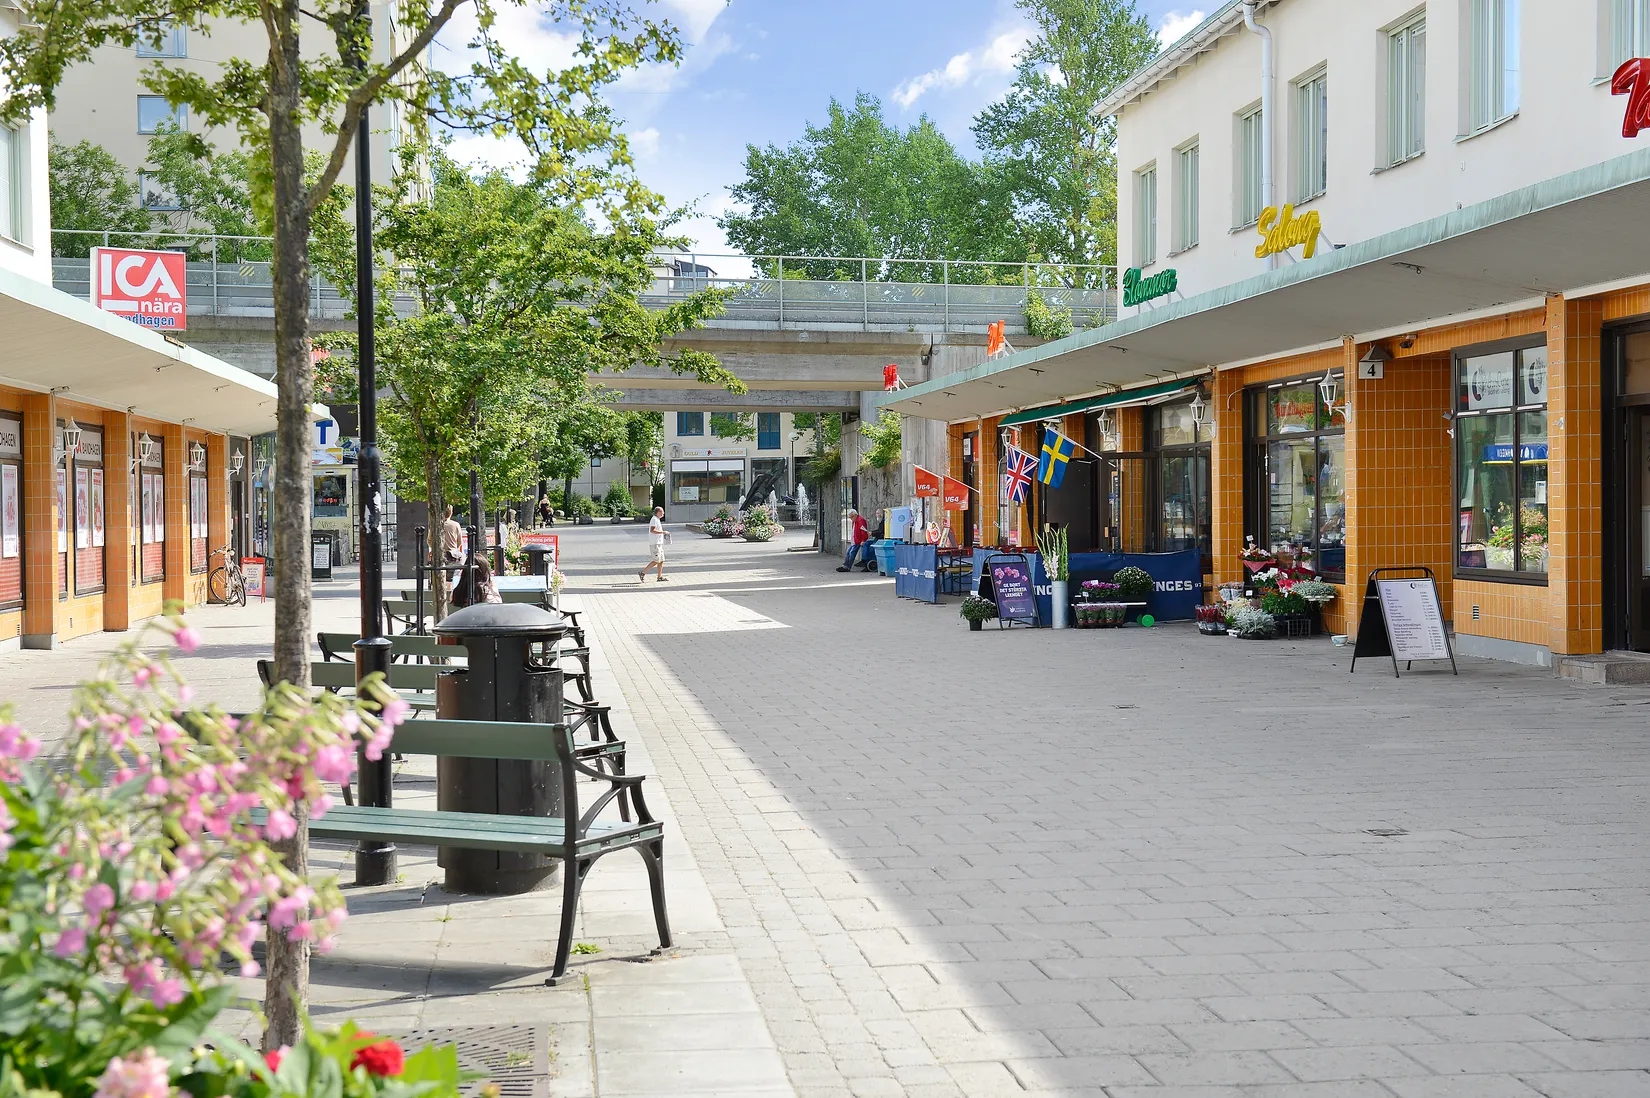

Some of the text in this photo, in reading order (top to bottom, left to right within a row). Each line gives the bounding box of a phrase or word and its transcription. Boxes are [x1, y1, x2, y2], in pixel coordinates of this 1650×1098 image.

[1255, 203, 1321, 259] Salong
[101, 253, 182, 299] ICA
[1123, 267, 1177, 307] Blommor
[140, 298, 183, 314] nära
[1367, 363, 1376, 376] 4
[315, 420, 334, 445] T
